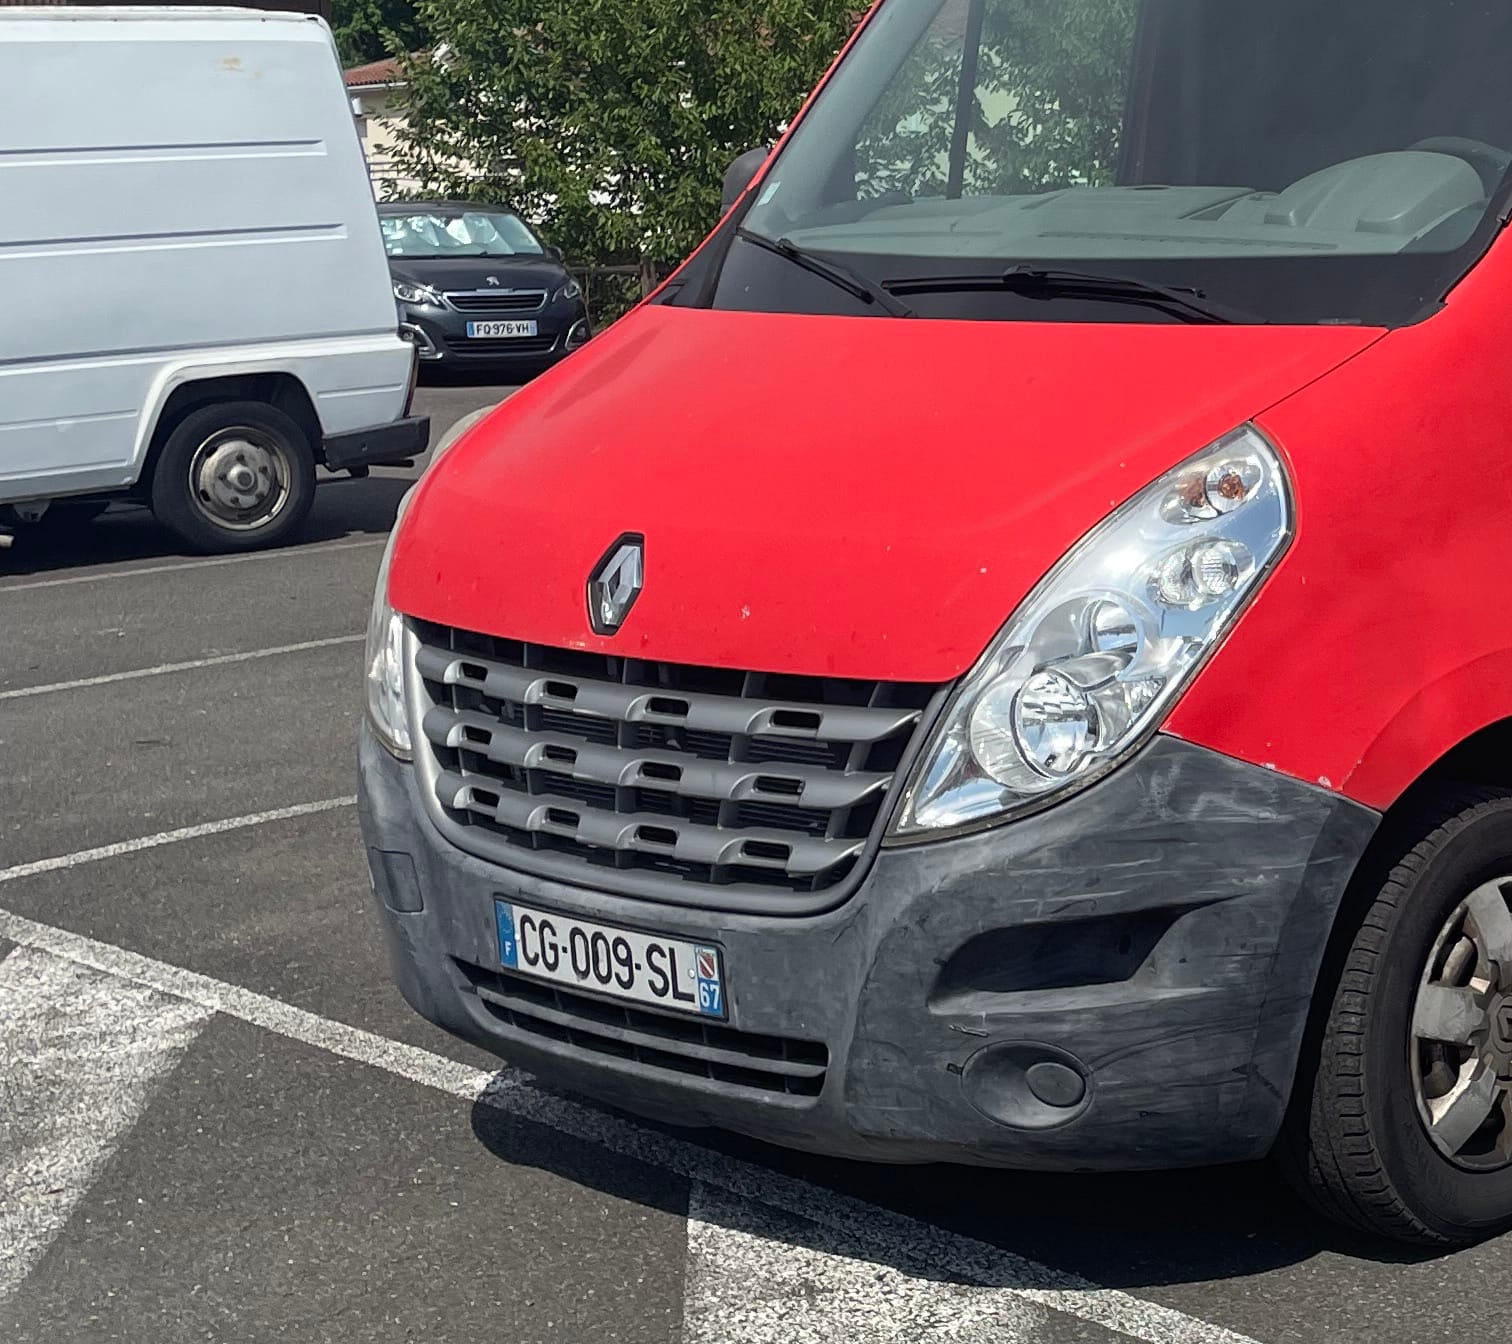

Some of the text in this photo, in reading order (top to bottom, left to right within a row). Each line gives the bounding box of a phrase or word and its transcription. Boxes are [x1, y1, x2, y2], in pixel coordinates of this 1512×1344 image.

[504, 941, 512, 956] F
[518, 913, 696, 1004] CG-009-SL
[699, 981, 721, 1009] 67
